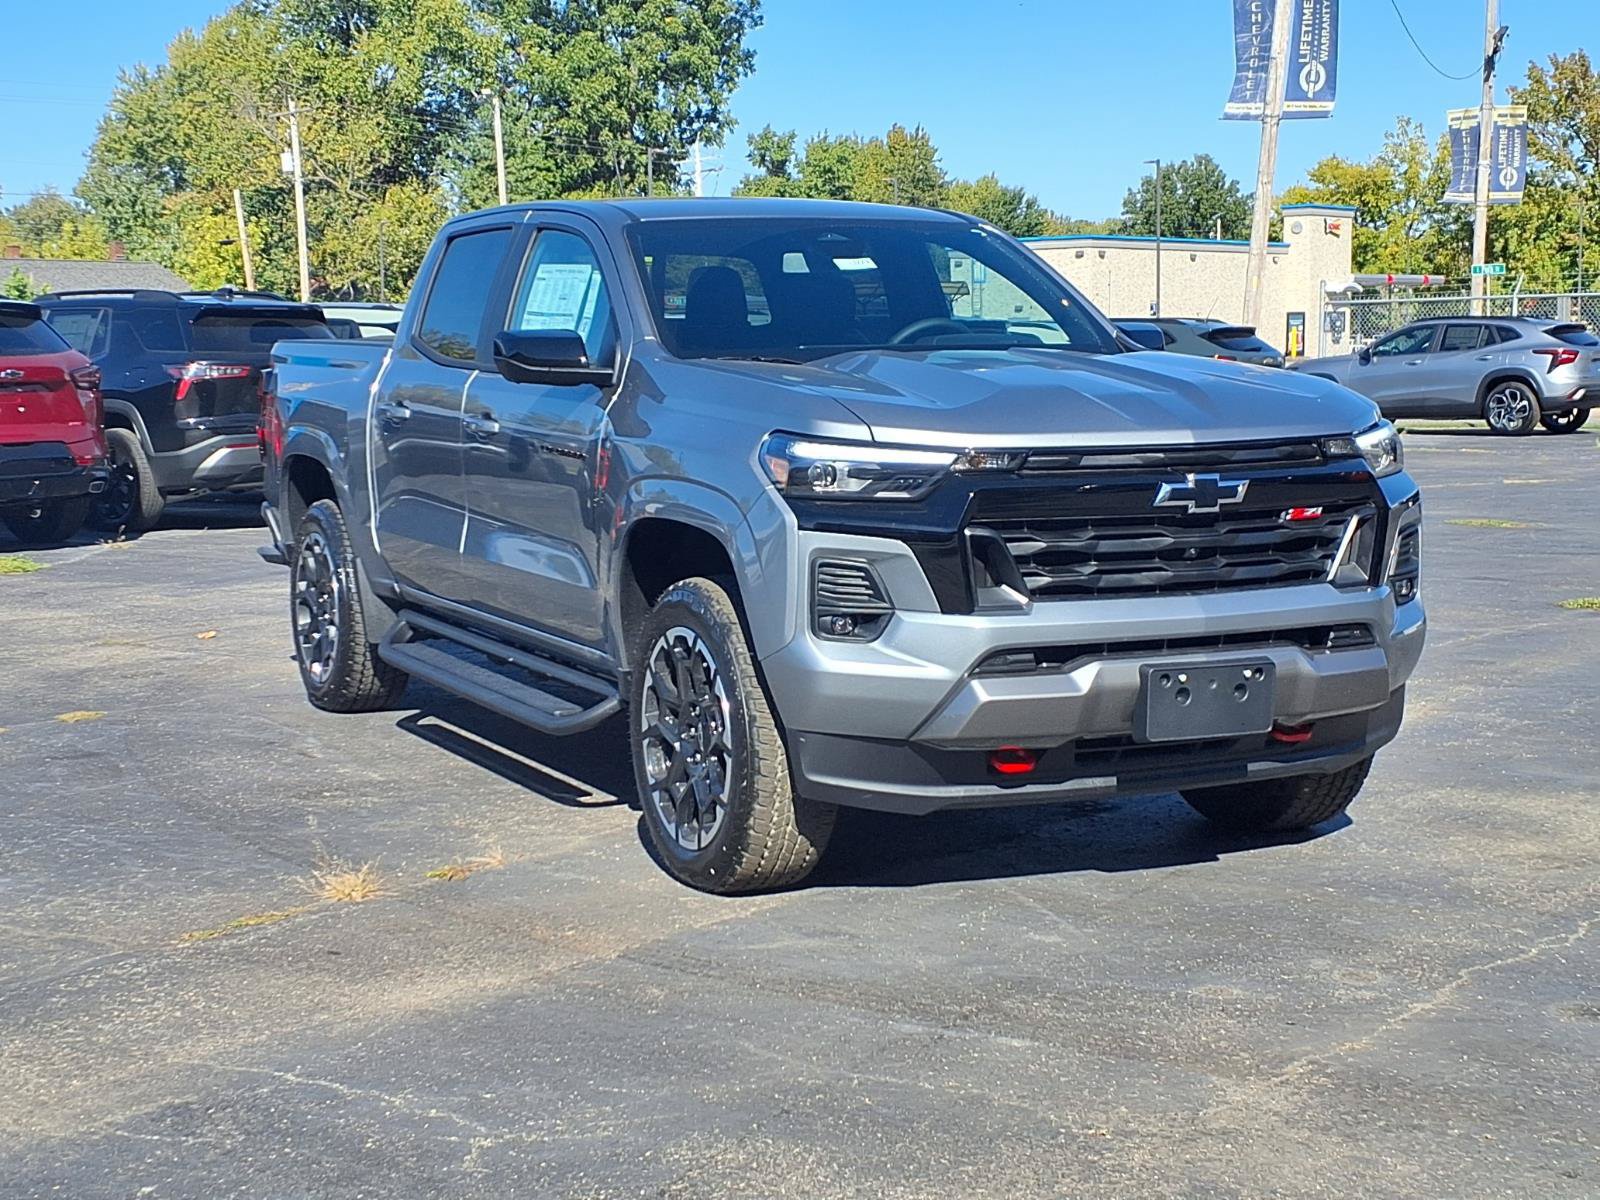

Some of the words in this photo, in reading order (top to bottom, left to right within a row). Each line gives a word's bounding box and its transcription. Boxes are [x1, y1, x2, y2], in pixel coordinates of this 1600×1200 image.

[1246, 2, 1261, 99] CHEVROLET
[1298, 0, 1314, 63] LIFETIME
[1319, 0, 1331, 62] WARRANTY
[1498, 128, 1508, 168] LIFETIME
[1513, 128, 1521, 168] WARRANTY
